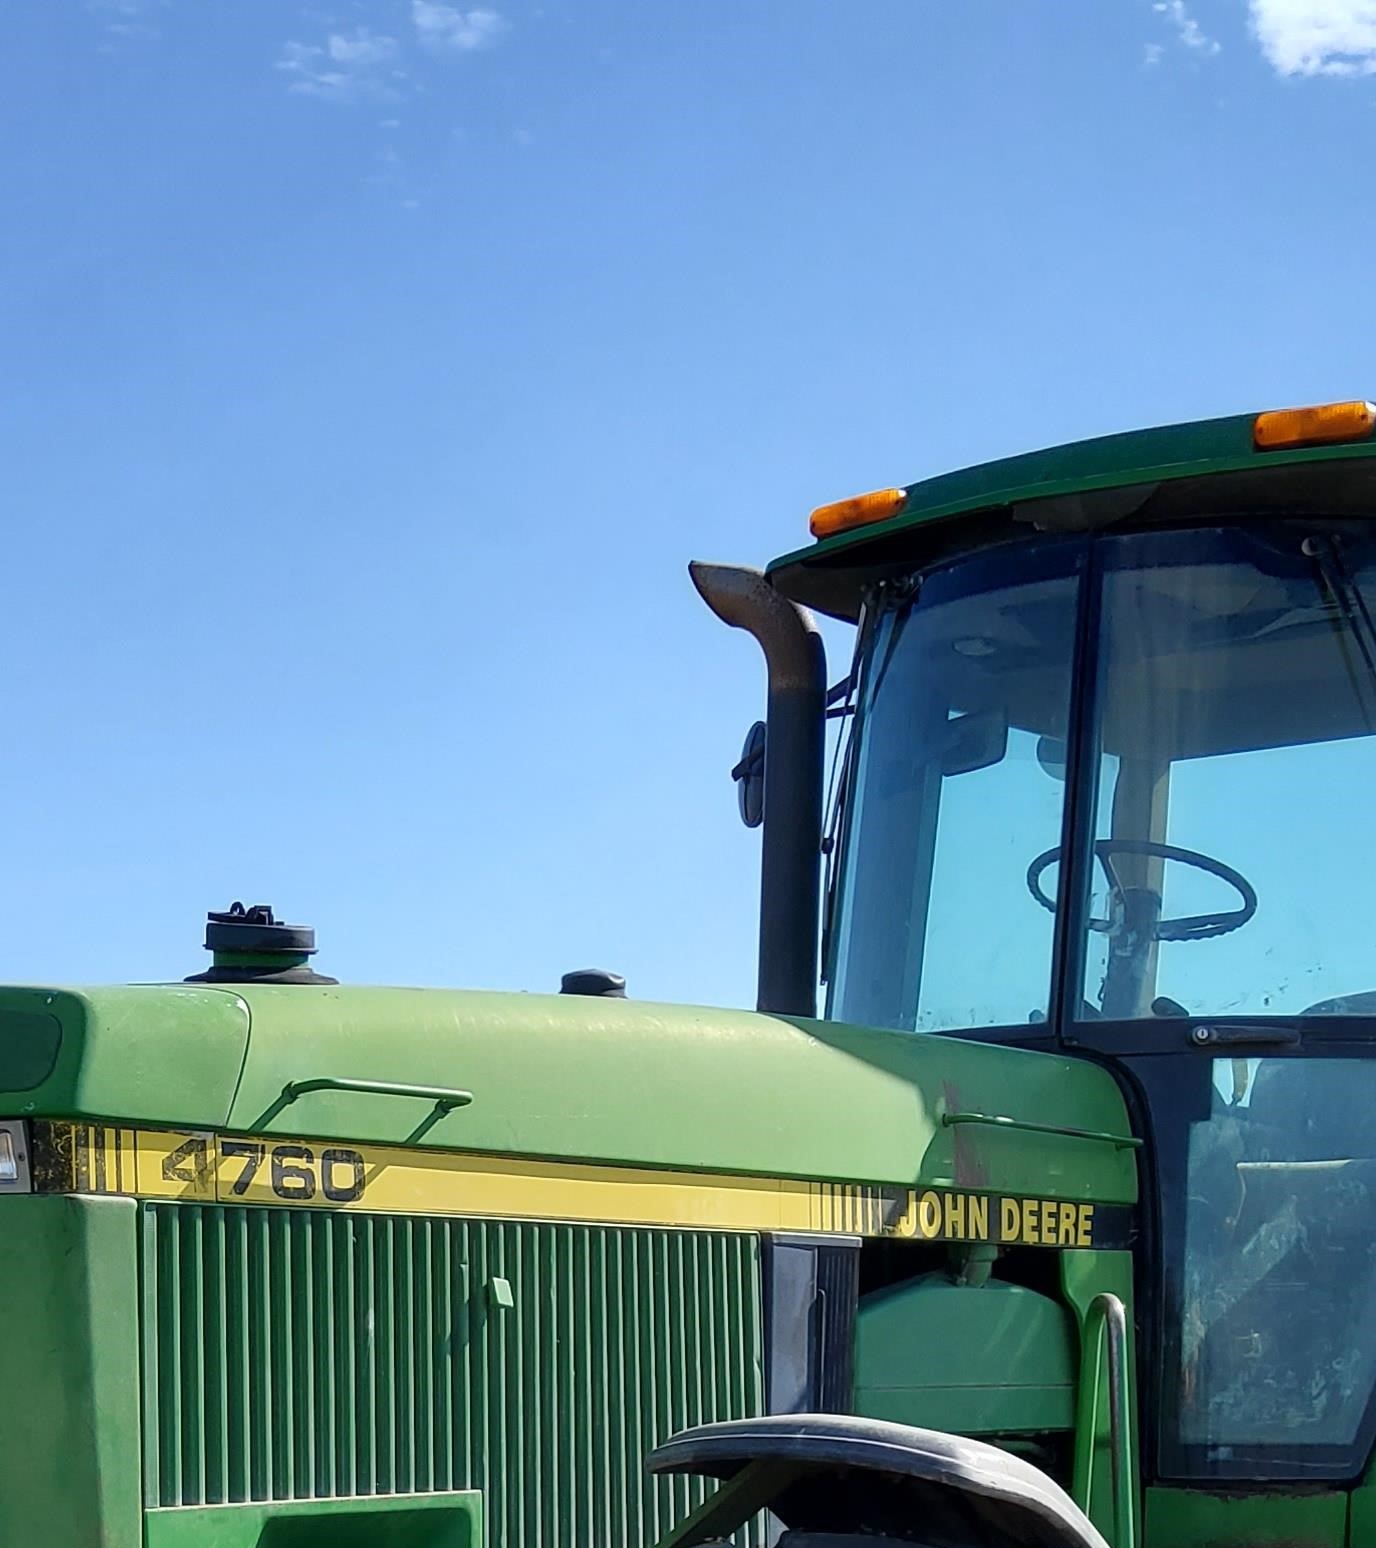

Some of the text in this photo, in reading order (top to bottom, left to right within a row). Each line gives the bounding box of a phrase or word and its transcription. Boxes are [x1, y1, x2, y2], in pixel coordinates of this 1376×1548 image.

[162, 1138, 366, 1201] 4760
[899, 1190, 1095, 1246] JOHN DEERE
